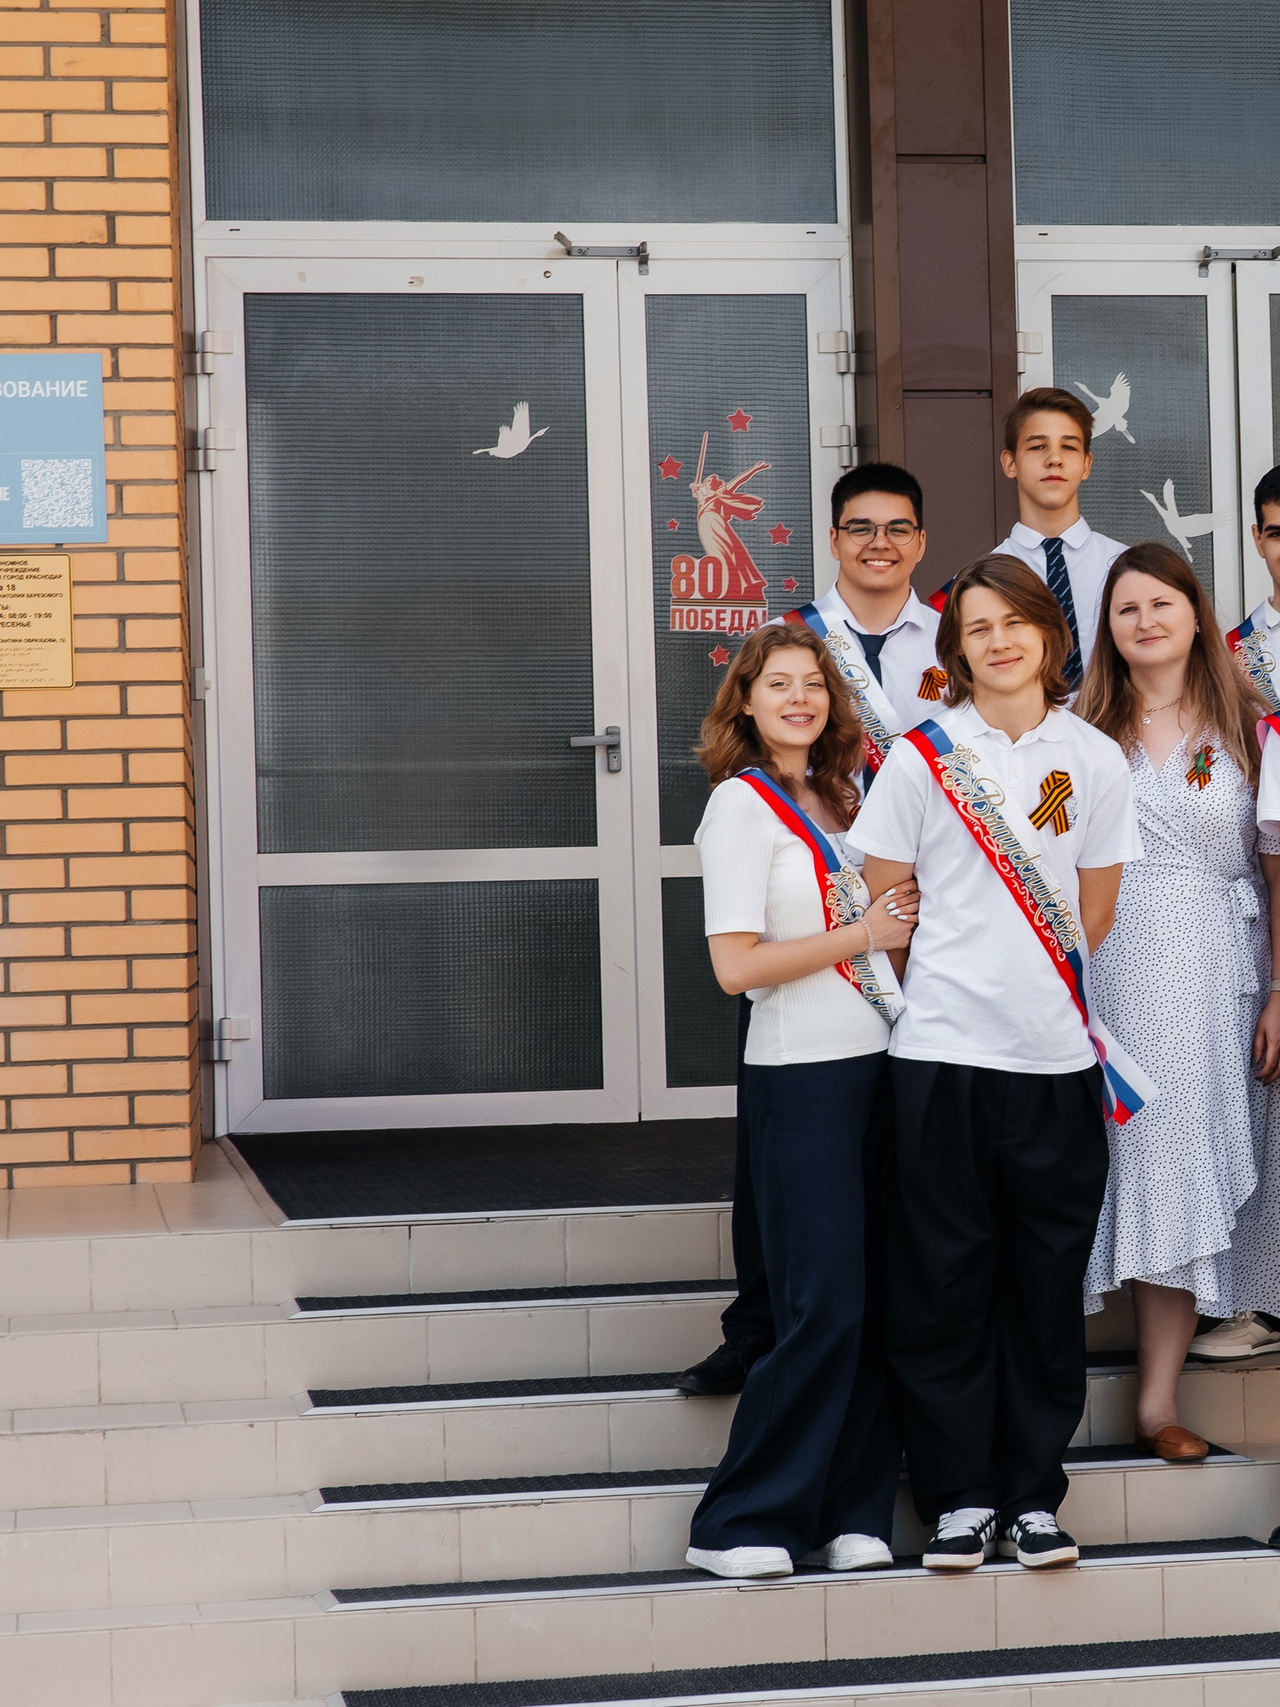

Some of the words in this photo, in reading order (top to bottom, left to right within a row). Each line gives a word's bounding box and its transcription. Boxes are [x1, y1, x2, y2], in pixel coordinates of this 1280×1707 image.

[0, 380, 88, 398] ОВАНИЕ
[671, 555, 723, 599] 80
[960, 777, 1062, 926] Выпускник
[1044, 899, 1082, 952] 2025
